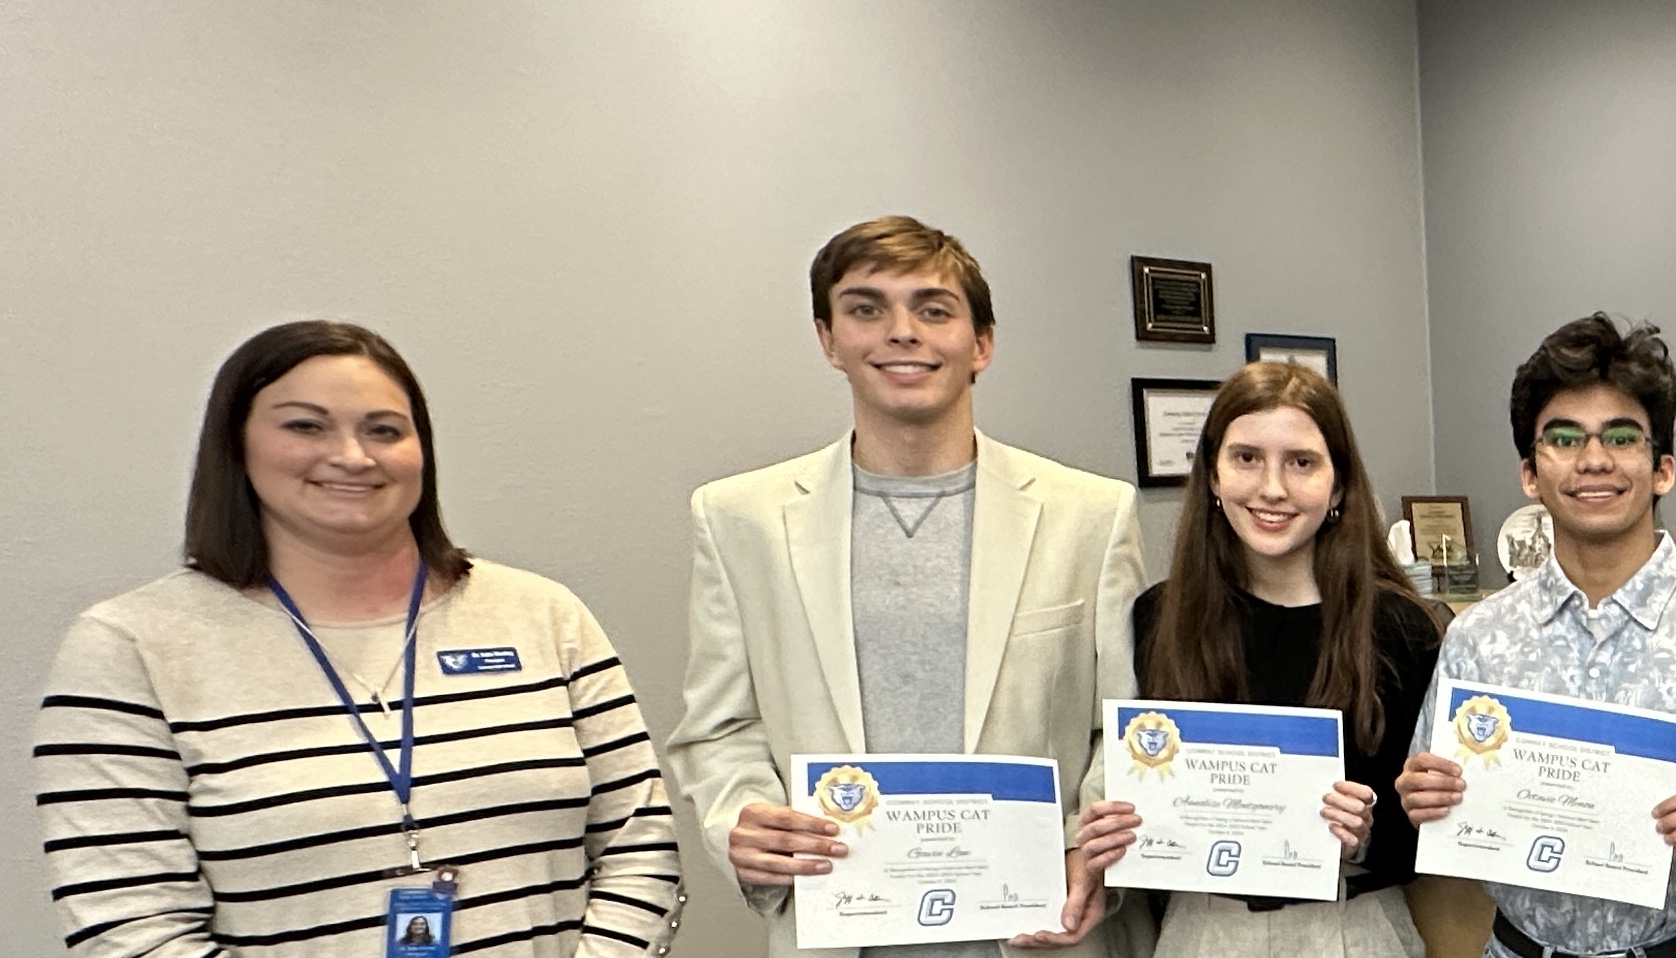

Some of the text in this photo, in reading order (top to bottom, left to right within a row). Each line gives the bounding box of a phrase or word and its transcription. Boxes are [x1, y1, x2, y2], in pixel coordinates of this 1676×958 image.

[1185, 758, 1278, 774] WAMPUS CAT
[1513, 748, 1611, 773] WAMPUS CAT
[1210, 773, 1250, 786] PRIDE
[1538, 766, 1581, 782] PRIDE
[886, 809, 990, 821] WAMPUS CAT
[917, 822, 962, 834] PRIDE
